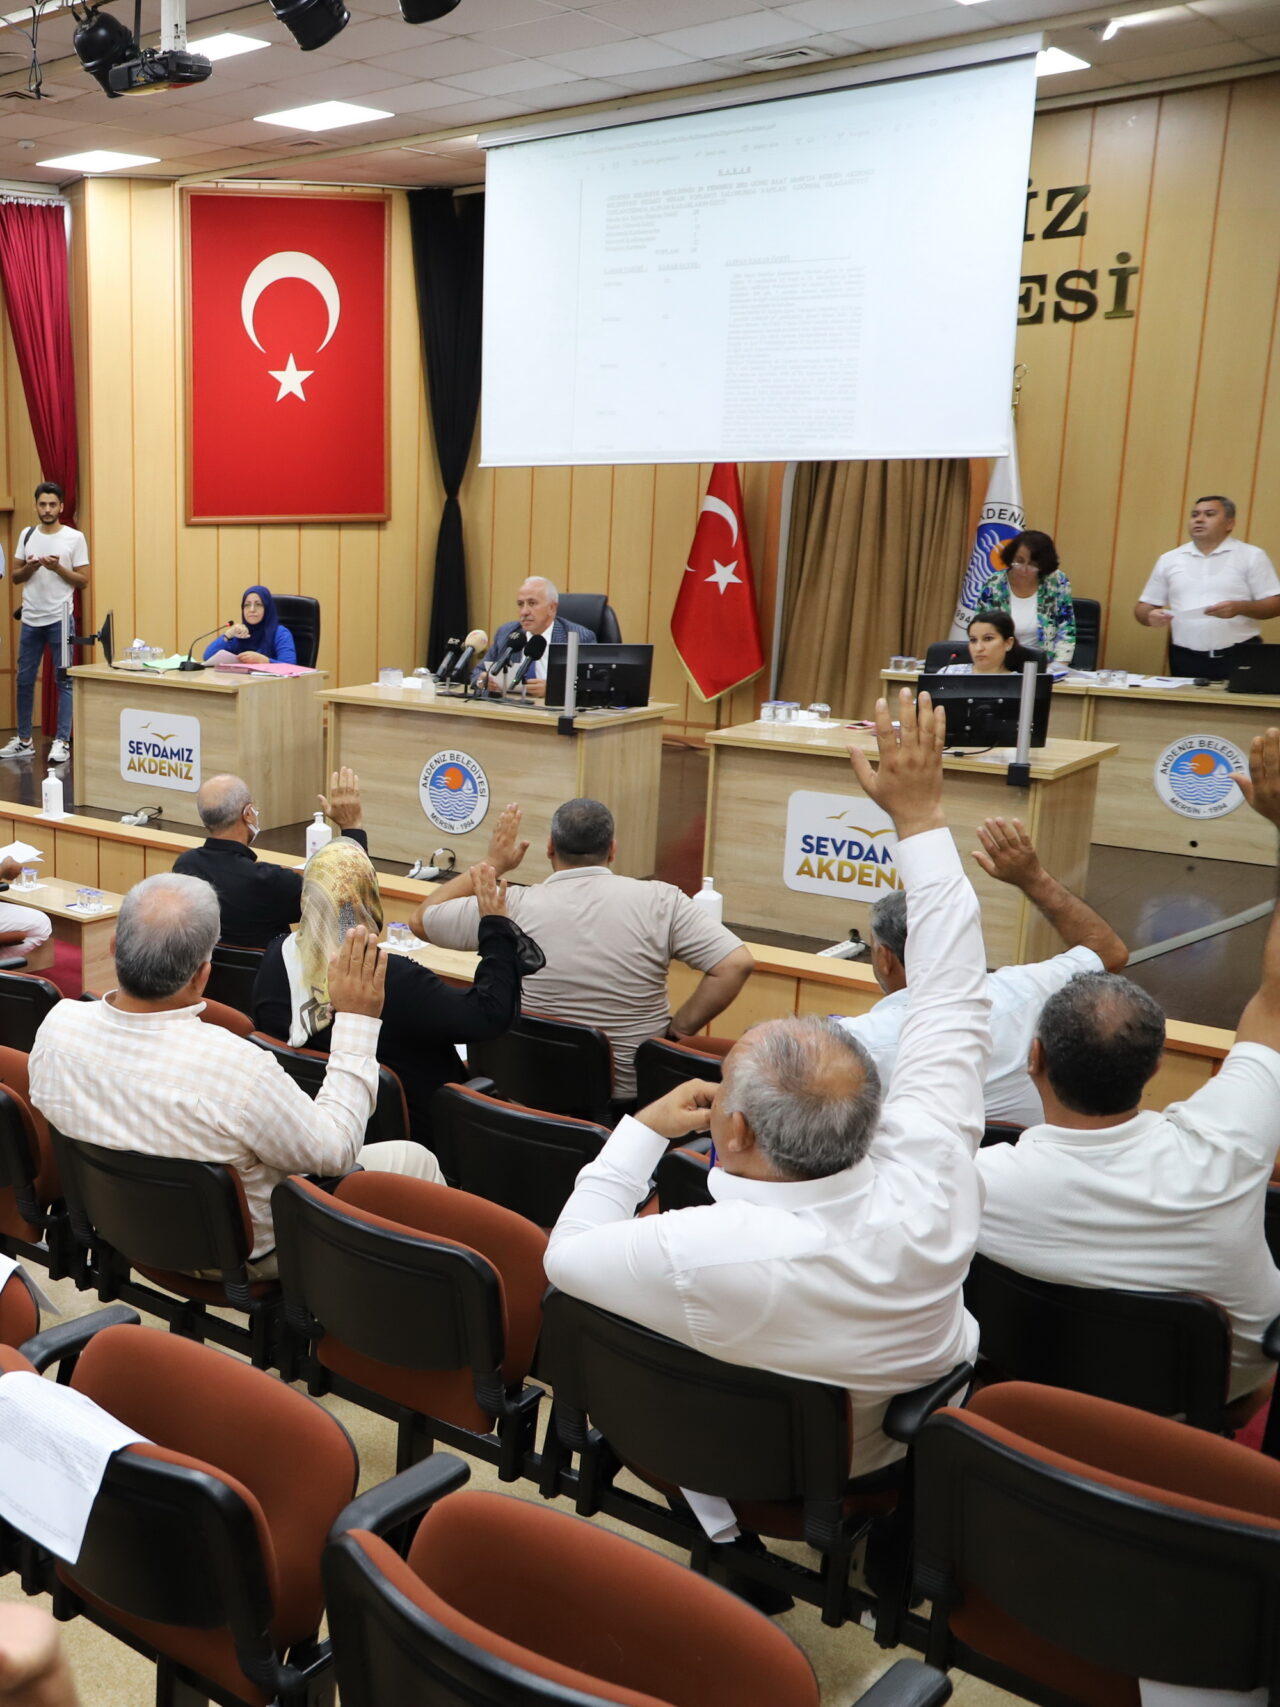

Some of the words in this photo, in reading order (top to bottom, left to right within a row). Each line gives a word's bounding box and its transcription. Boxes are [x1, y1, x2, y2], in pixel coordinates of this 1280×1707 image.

[128, 740, 193, 763] SEVDAMIZ
[1160, 741, 1196, 775] AKDENİZ
[127, 757, 193, 781] AKDENİZ
[422, 754, 447, 789] AKDENİZ
[450, 753, 488, 797] BELEDİYESİ
[430, 812, 455, 830] MERSİN
